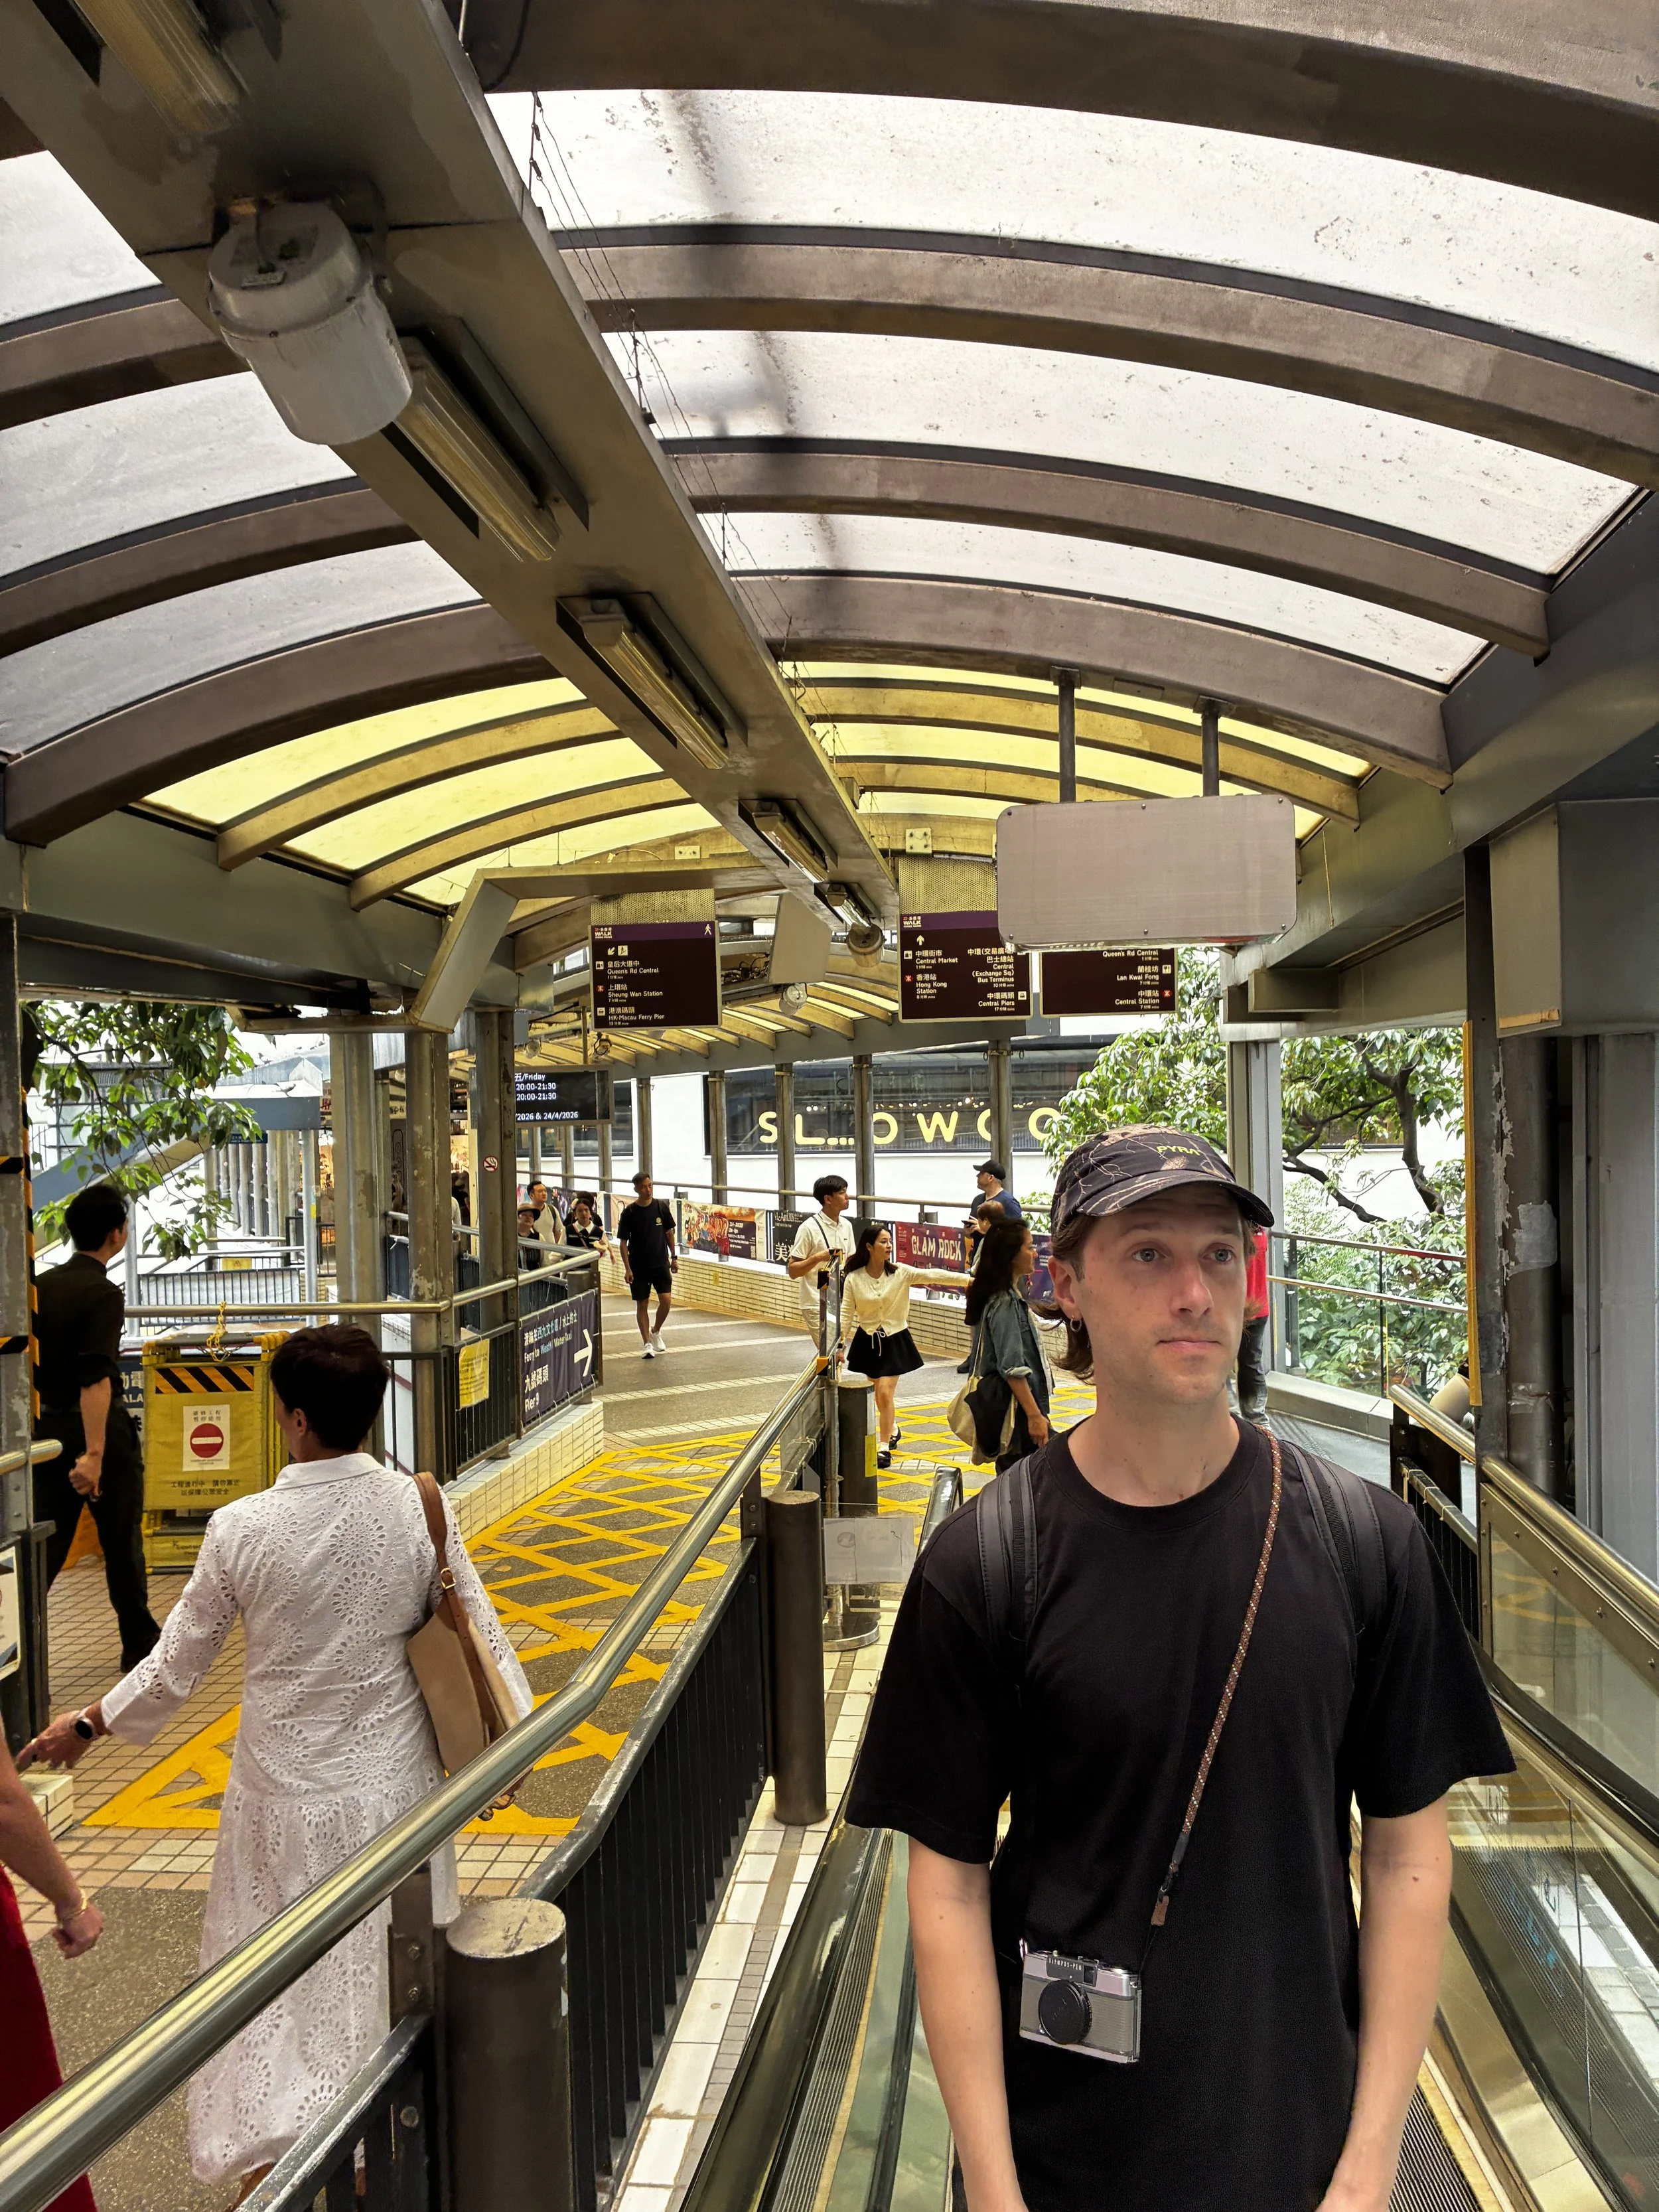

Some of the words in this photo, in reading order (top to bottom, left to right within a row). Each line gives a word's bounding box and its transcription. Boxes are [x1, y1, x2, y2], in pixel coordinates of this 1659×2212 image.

[543, 1112, 578, 1120] 24/4/2026
[911, 1235, 936, 1258] GLAM
[938, 1238, 962, 1261] ROCK
[524, 1351, 534, 1364] Ferry
[535, 1348, 540, 1358] to
[553, 1336, 565, 1348] Water
[525, 1364, 548, 1393] 九號碼頭
[525, 1397, 536, 1412] Pier
[536, 1392, 539, 1405] 9
[1048, 1958, 1082, 1970] OLYMPUS-PEN
